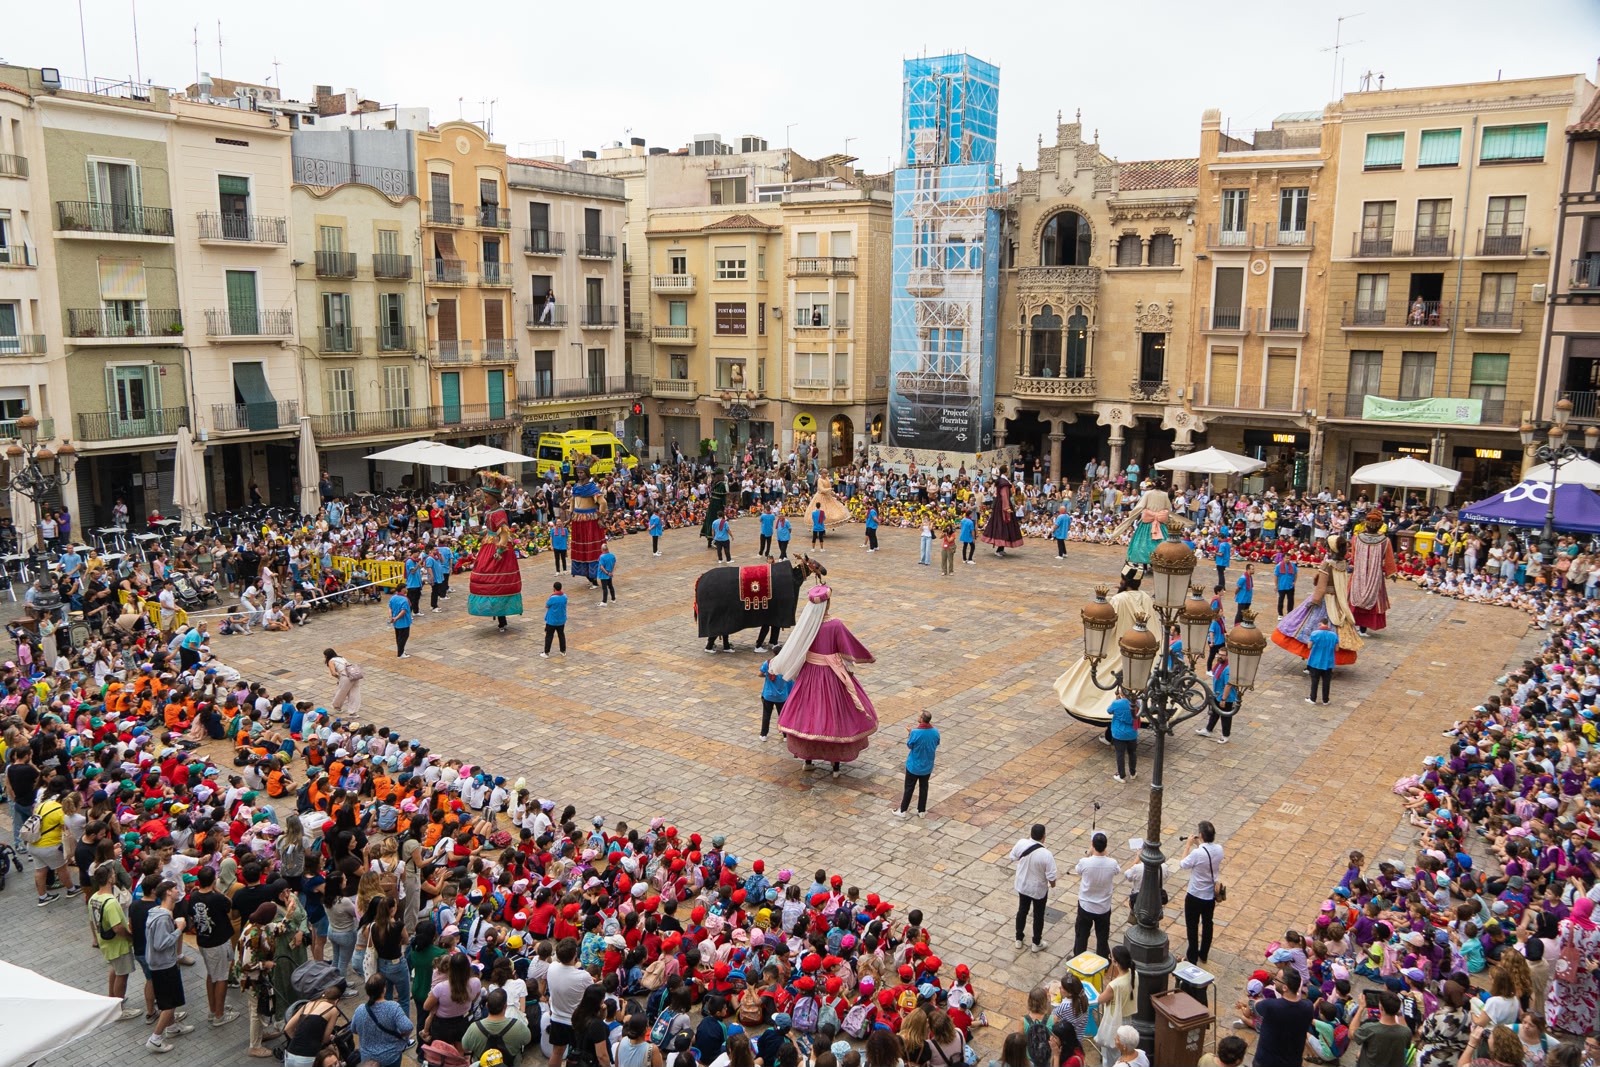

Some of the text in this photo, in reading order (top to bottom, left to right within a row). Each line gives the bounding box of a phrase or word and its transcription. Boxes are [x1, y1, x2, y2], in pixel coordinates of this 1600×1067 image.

[525, 408, 611, 422] FARMACIA MONTEVERDE
[943, 409, 968, 417] Projecte
[1273, 434, 1295, 443] VIVARI
[1476, 449, 1502, 458] VIVARI
[1464, 513, 1488, 521] Aigües
